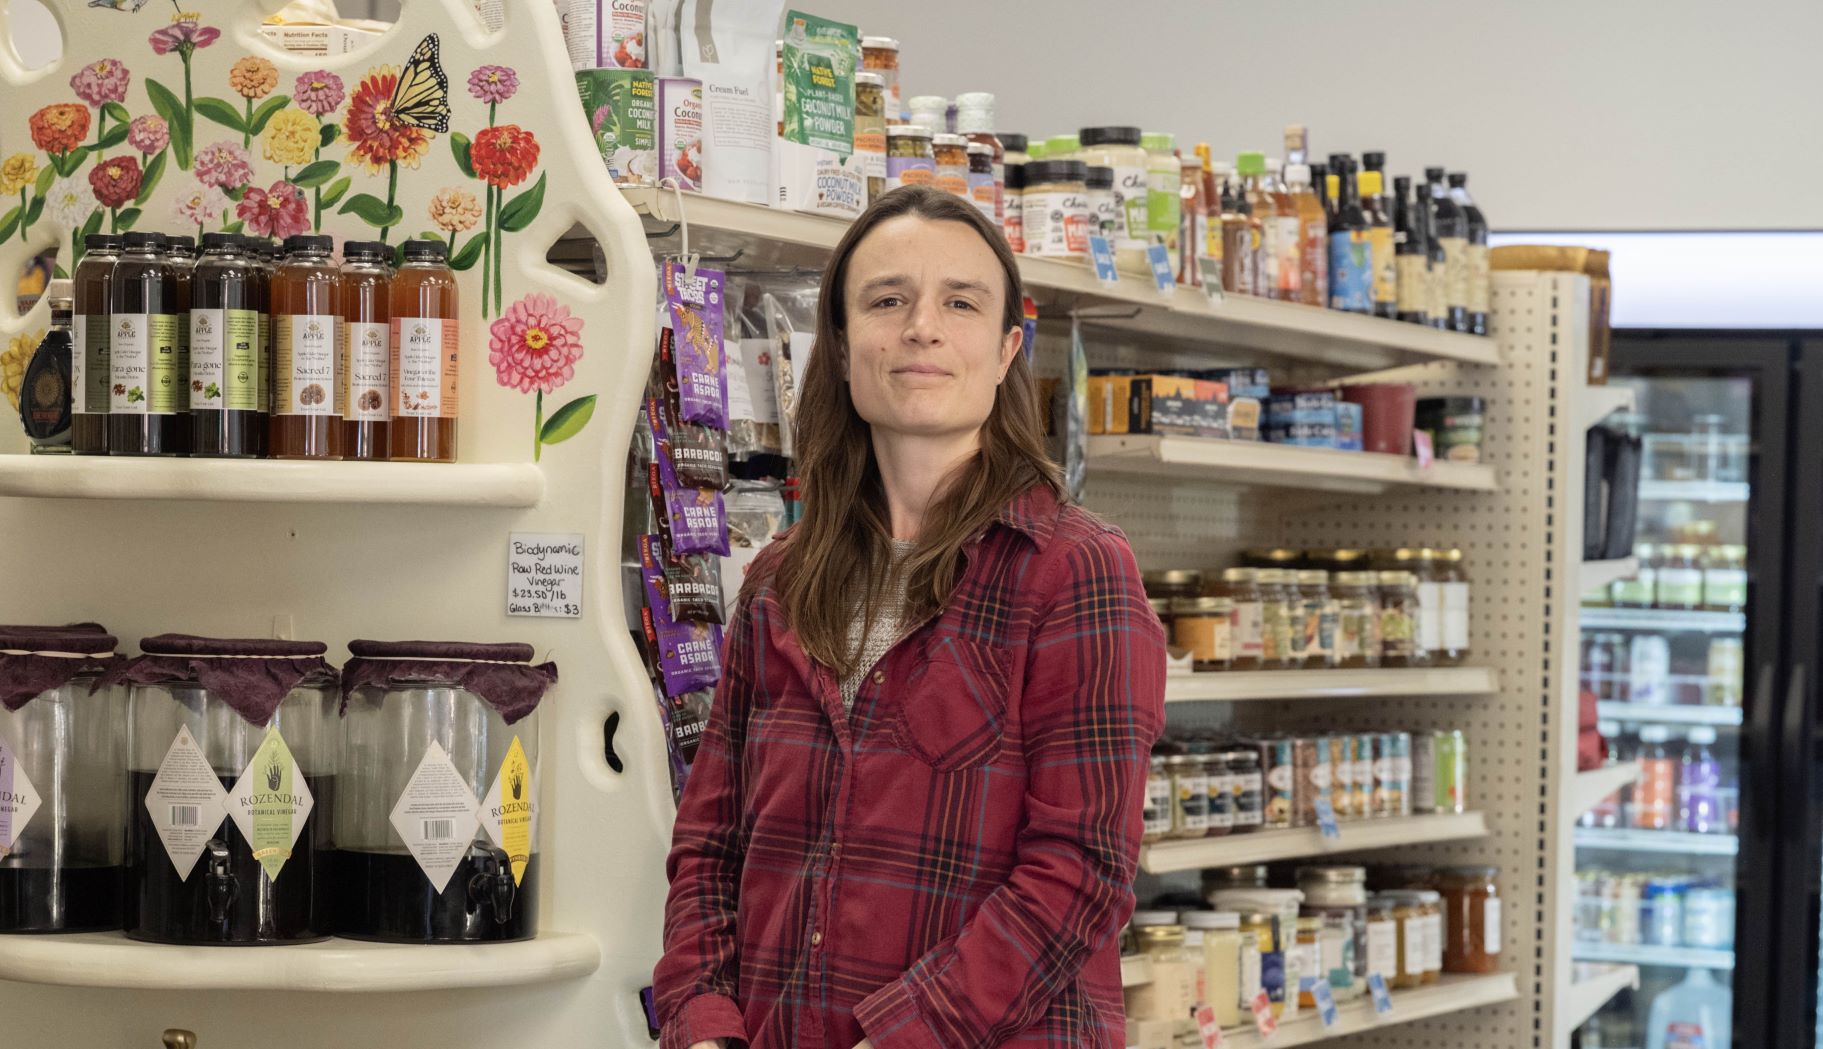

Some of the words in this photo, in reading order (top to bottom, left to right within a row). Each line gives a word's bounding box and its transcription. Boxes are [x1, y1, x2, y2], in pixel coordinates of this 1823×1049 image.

[812, 75, 836, 88] FOREST
[709, 84, 734, 95] Cream
[734, 86, 749, 96] Fuel
[801, 97, 836, 115] COCONUT
[636, 119, 652, 130] MILK
[814, 116, 846, 135] POWDER
[817, 176, 849, 190] COCONUT
[675, 272, 709, 292] STEET
[679, 286, 705, 305] TACOS
[296, 367, 325, 375] Sacred
[326, 366, 331, 375] 7
[354, 372, 382, 381] Sacred
[383, 372, 388, 381] 7
[691, 372, 720, 388] CARNE
[693, 383, 720, 399] ASADA
[684, 506, 717, 517] CARNE
[686, 517, 719, 528] ASADA
[513, 541, 581, 561] Biodynamic
[511, 562, 532, 574] Raw
[534, 562, 552, 575] Red
[554, 564, 580, 576] Wine
[526, 576, 566, 592] Vinegar
[509, 602, 531, 613] Glass
[564, 603, 580, 615] $3
[677, 639, 713, 654] CARNE
[680, 651, 714, 665] ASADA
[675, 719, 708, 738] BARB
[240, 793, 305, 807] ROZENDAL
[247, 808, 276, 816] BOTANICAL
[491, 802, 535, 818] ROZENDAL
